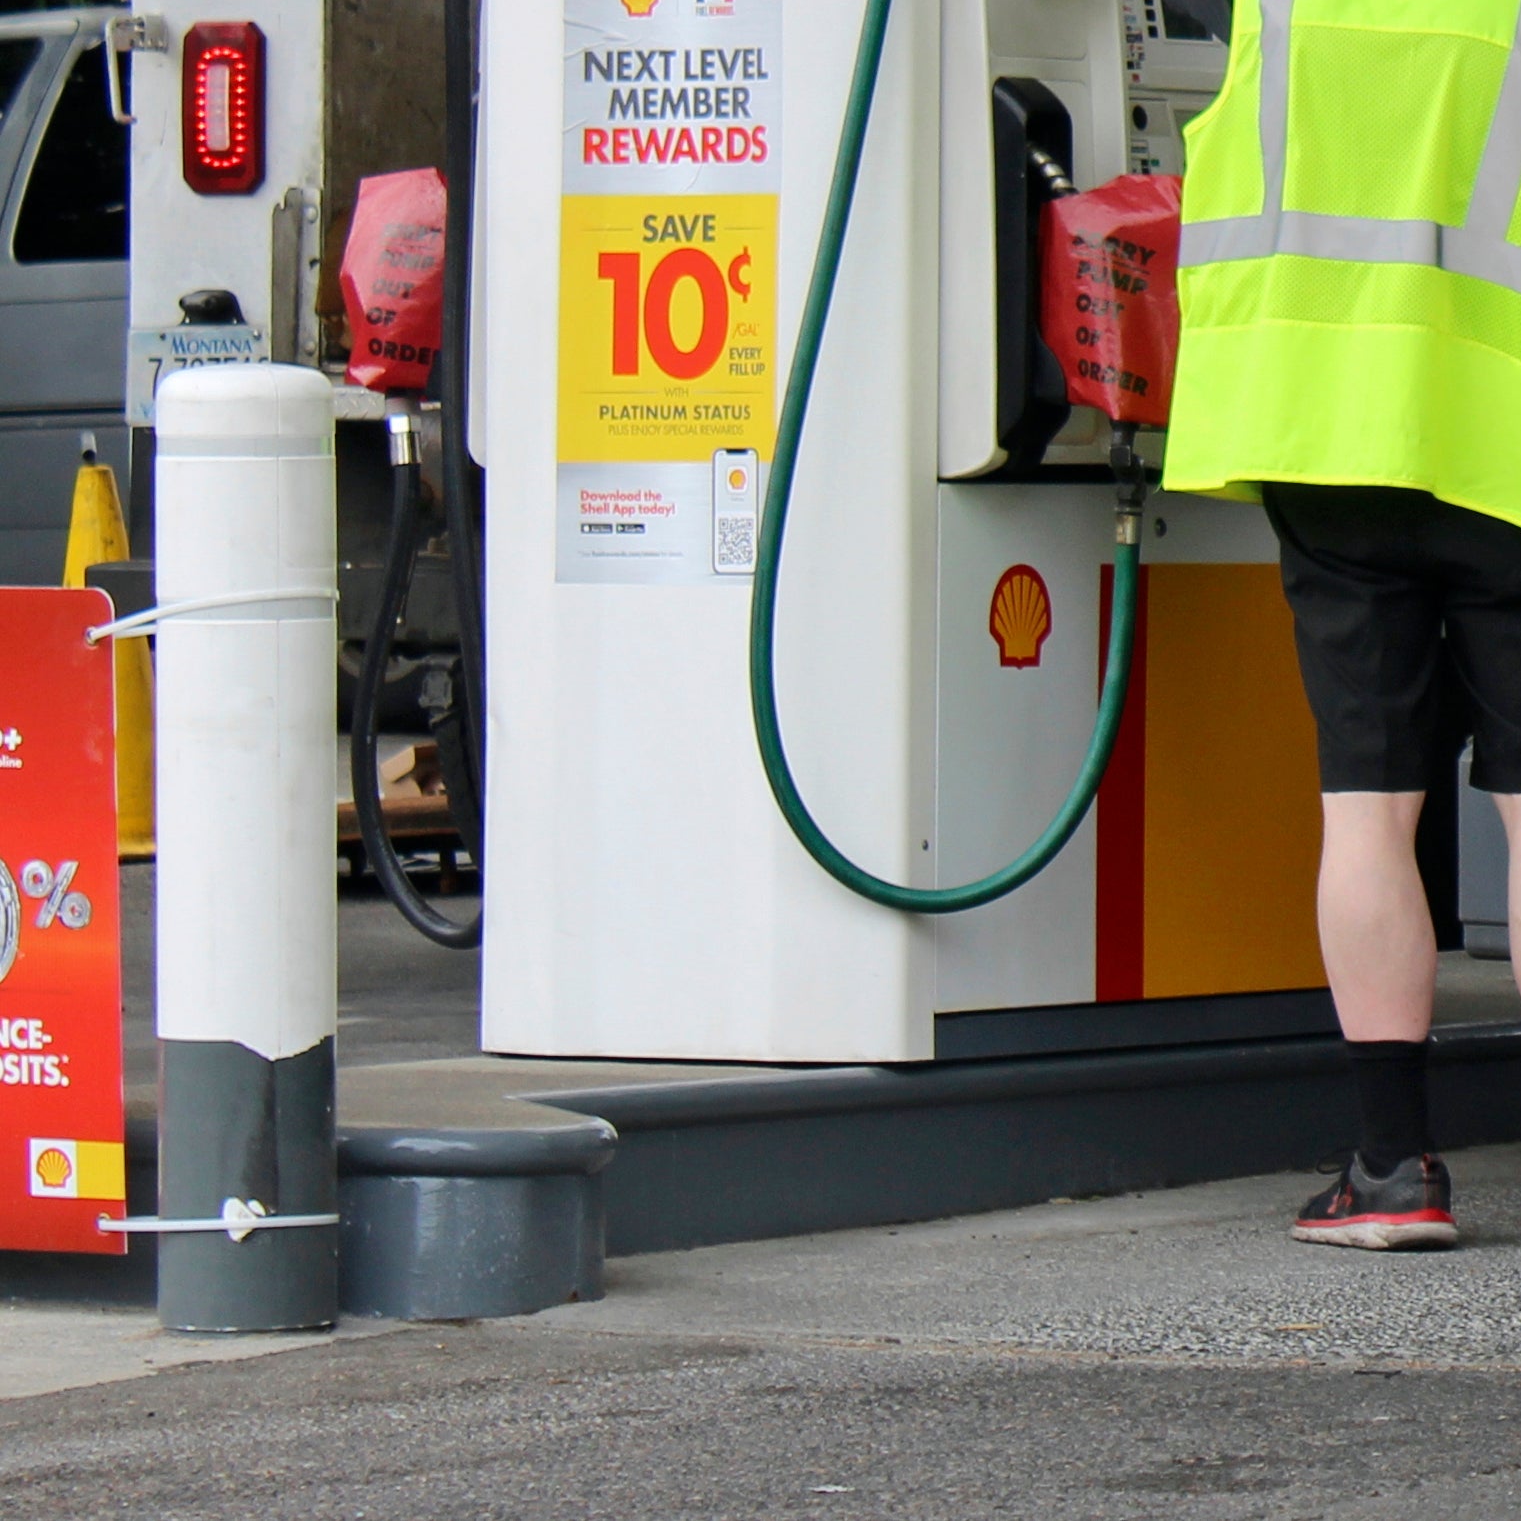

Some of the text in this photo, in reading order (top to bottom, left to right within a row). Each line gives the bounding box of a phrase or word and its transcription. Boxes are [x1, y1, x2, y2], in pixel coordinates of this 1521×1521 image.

[584, 48, 768, 82] NEXT LEVEL
[608, 87, 753, 120] MEMBER
[583, 125, 769, 165] REWARDS
[642, 214, 716, 243] SAVE
[1076, 260, 1149, 295] PUMP
[366, 306, 397, 326] OF
[1075, 293, 1125, 321] OUT
[171, 333, 253, 355] MONTANA
[367, 337, 434, 367] ORDE
[729, 347, 762, 361] EVERY
[729, 362, 766, 376] FILL UP
[1077, 358, 1150, 398] ORDER
[664, 387, 690, 398] WITH
[599, 404, 752, 421] PLATINUM STATUS
[700, 425, 745, 436] REWARDS
[580, 490, 662, 502] Download the
[580, 503, 676, 518] Shell App today!
